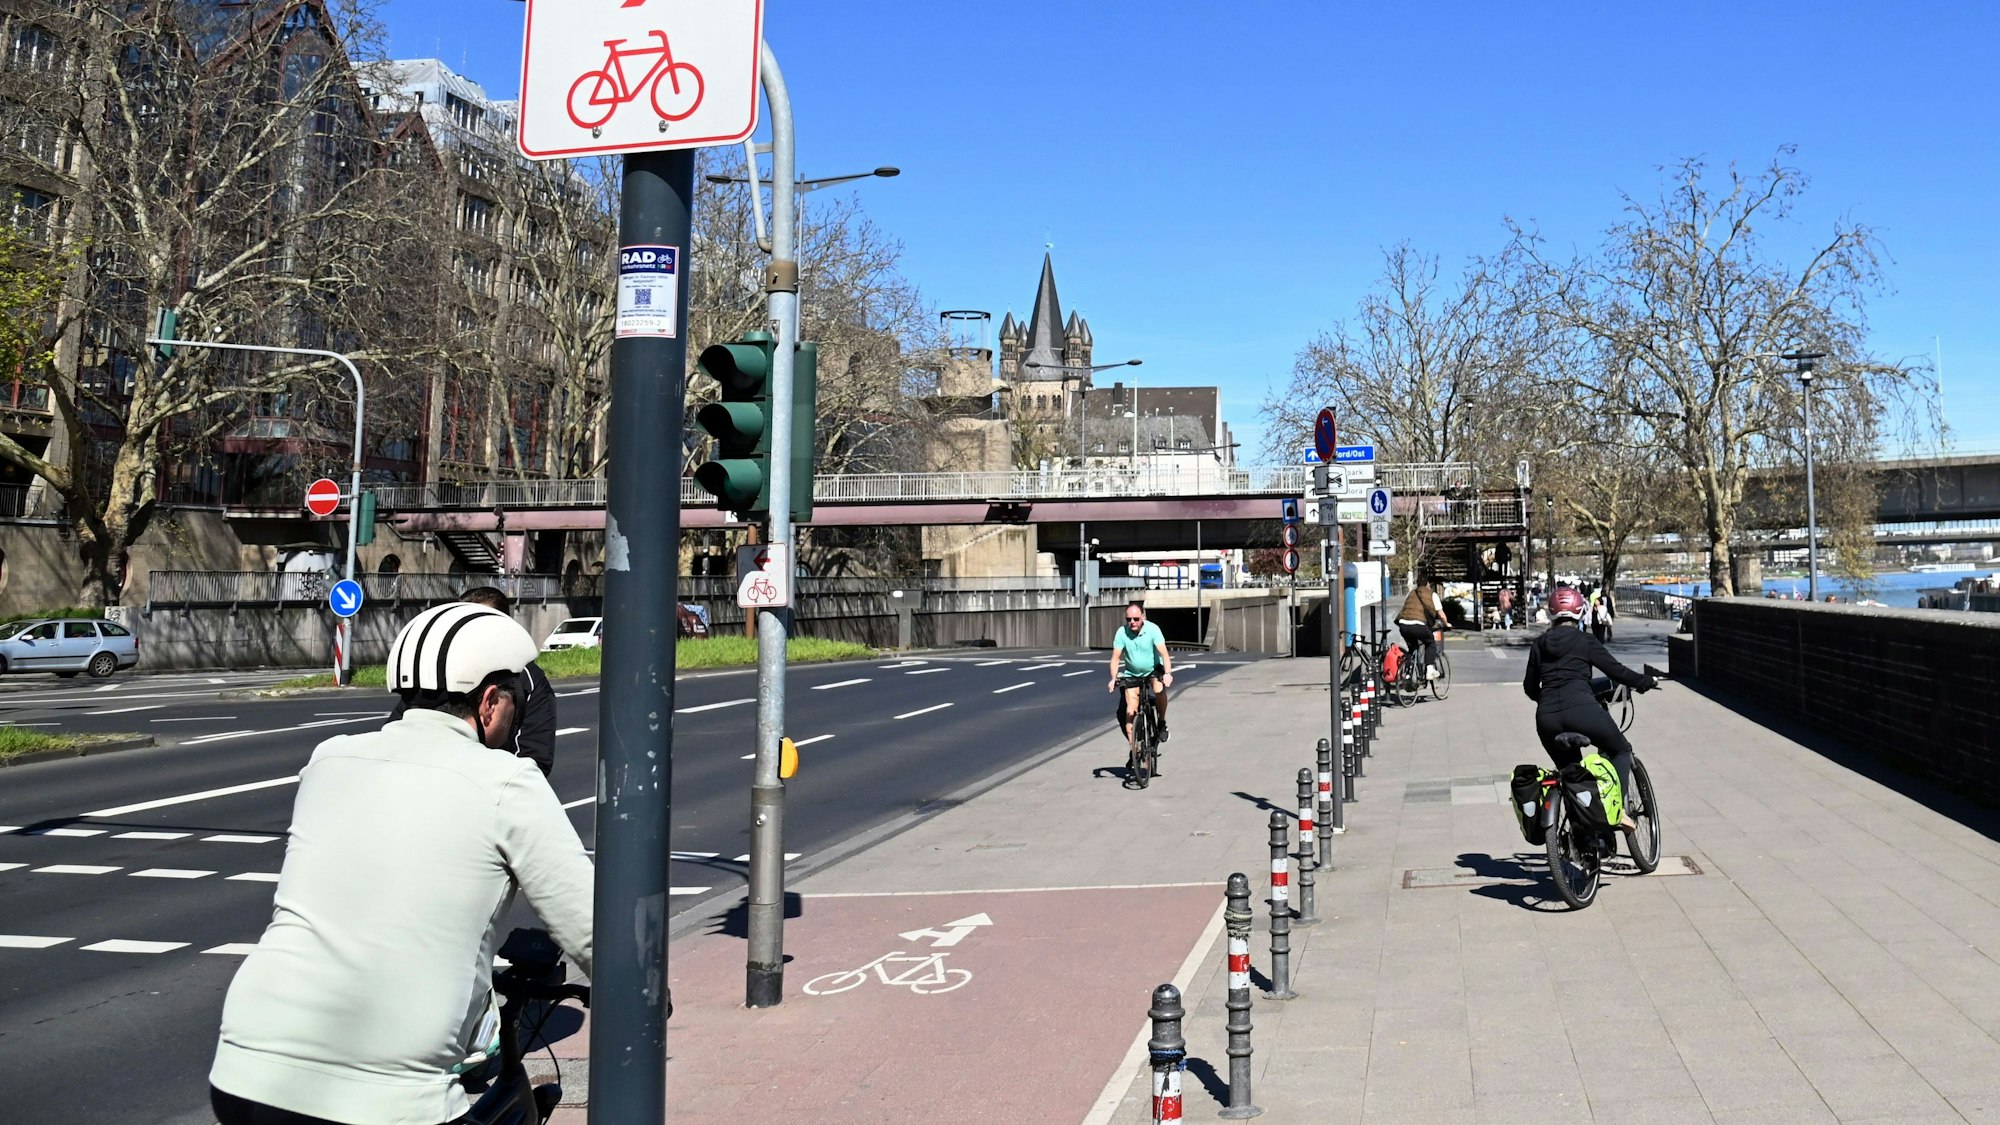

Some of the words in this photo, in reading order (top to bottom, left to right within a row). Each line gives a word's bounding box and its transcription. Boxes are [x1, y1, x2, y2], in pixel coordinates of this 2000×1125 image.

[621, 251, 656, 265] RAD
[1347, 468, 1363, 477] park
[1348, 487, 1363, 495] lora
[1373, 514, 1386, 522] ZONE
